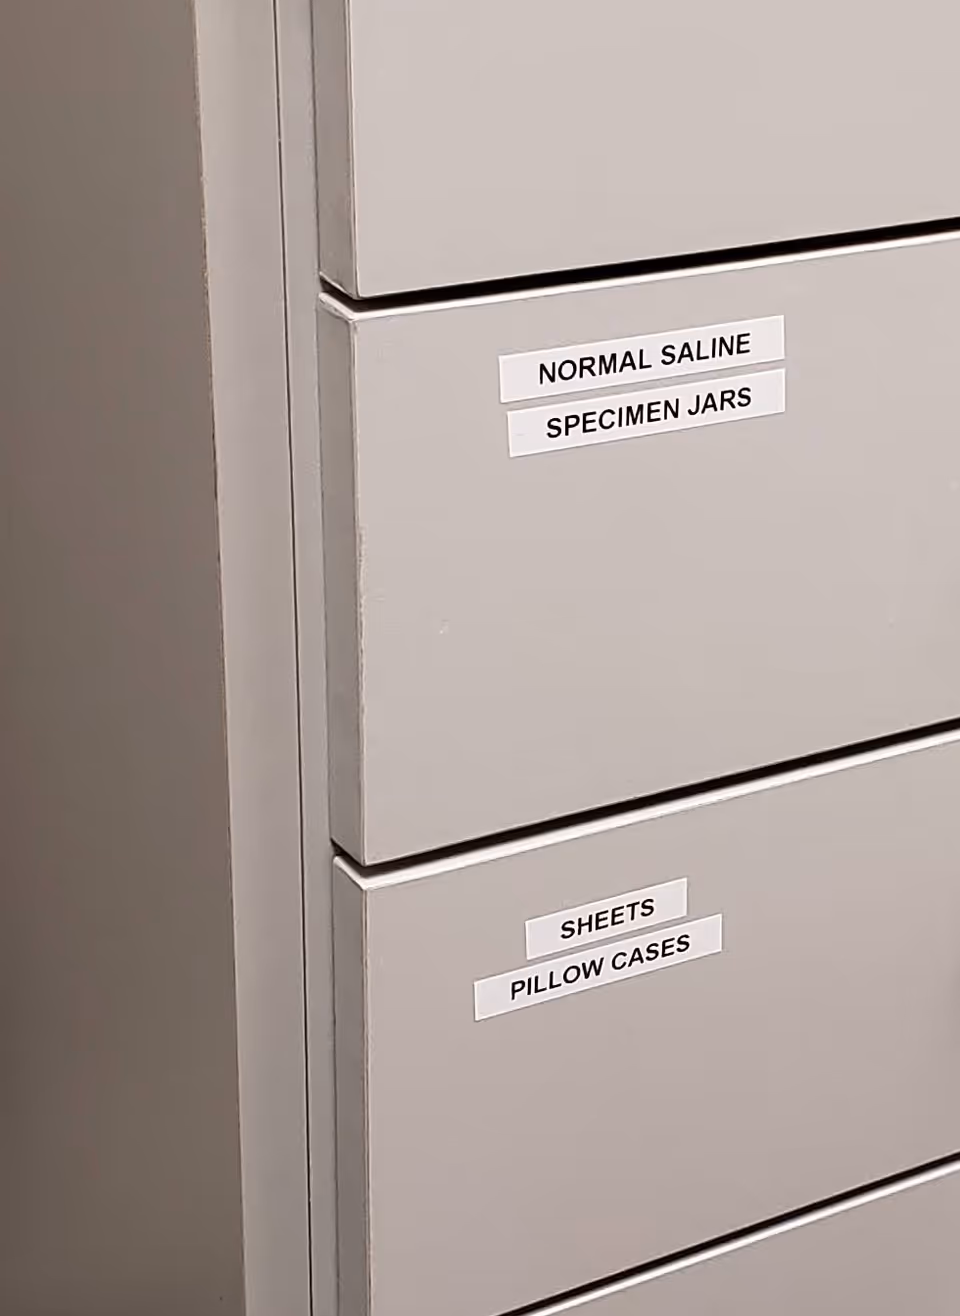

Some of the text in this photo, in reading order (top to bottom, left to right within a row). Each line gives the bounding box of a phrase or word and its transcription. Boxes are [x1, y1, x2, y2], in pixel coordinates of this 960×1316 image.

[538, 332, 751, 386] NORMAL SALINE
[546, 386, 752, 439] SPECIMEN JARS
[559, 898, 655, 940] SHEETS
[510, 933, 691, 1001] PILLOW CASES
